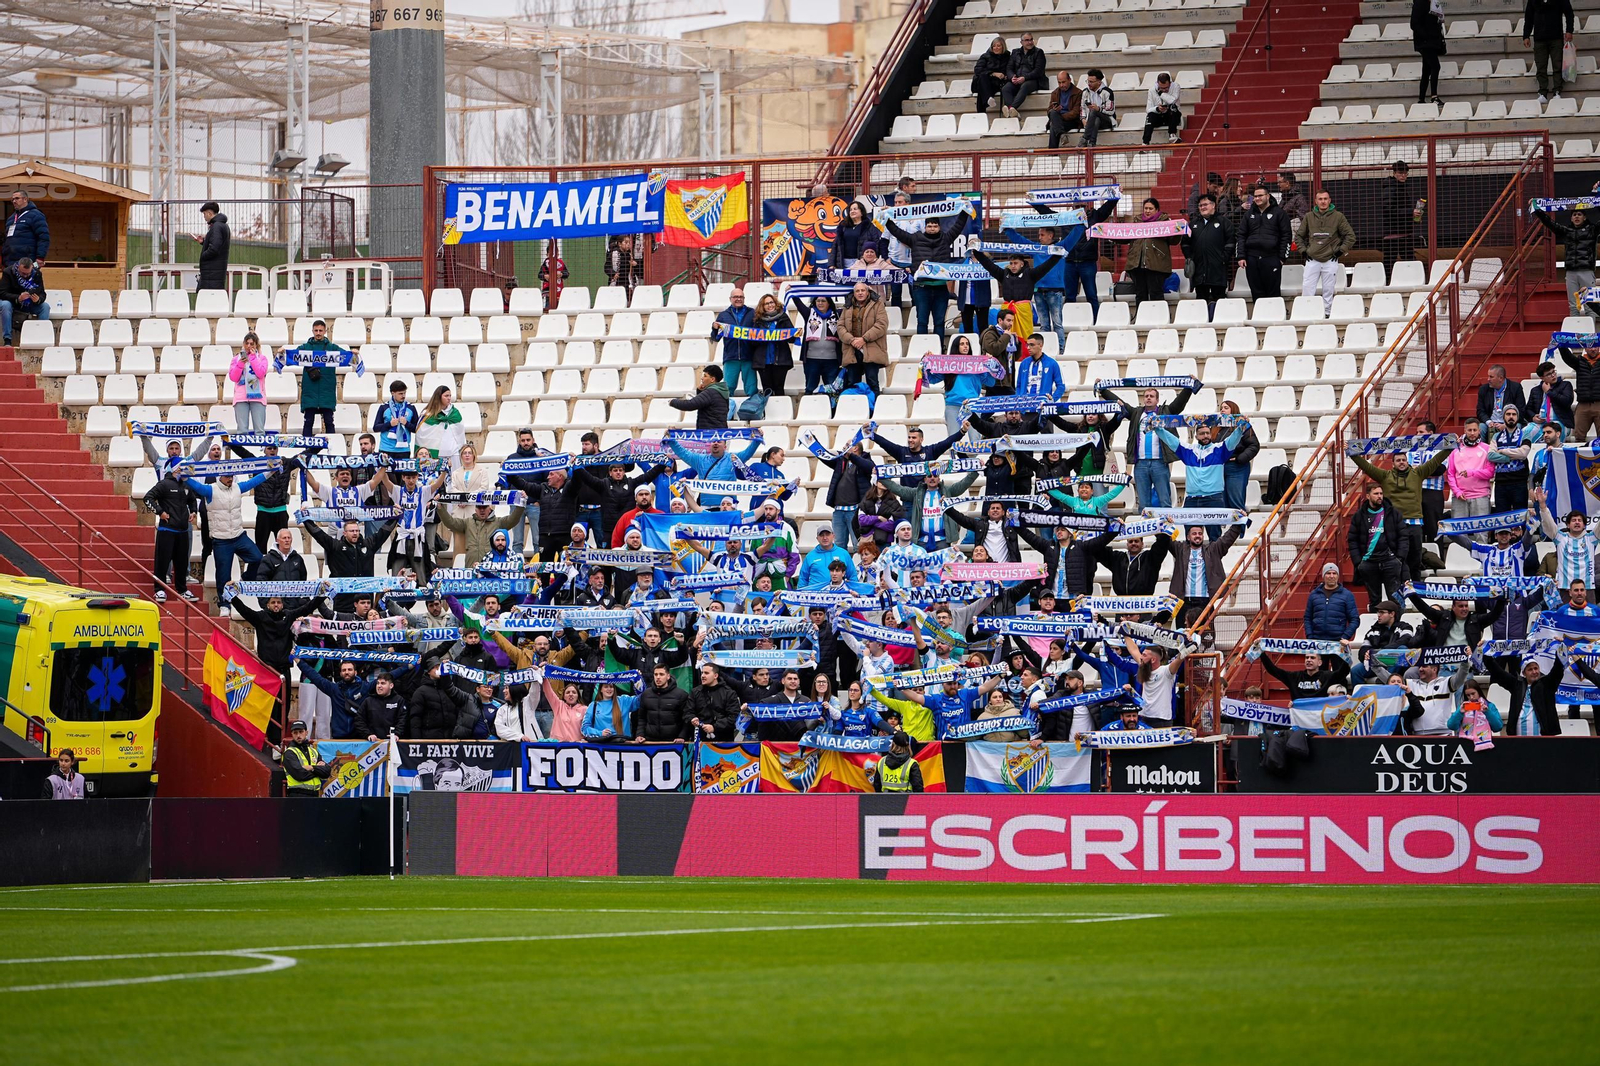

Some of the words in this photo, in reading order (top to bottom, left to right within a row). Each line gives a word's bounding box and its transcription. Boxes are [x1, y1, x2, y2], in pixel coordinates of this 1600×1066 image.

[394, 8, 420, 21] 667
[1036, 192, 1080, 200] MALAGA
[456, 182, 659, 232] BENAMIEL
[911, 202, 955, 216] HICIMOS!
[1106, 226, 1171, 237] MALAGUISTA
[765, 237, 787, 262] MALAGA
[733, 326, 791, 340] BENAMIEL
[1135, 377, 1194, 387] SUPERPANTERA
[164, 424, 205, 434] HERRERO
[229, 434, 275, 444] FONDO
[296, 437, 324, 446] SUR
[675, 431, 744, 441] MALAGA
[505, 462, 532, 470] PORQUE
[542, 458, 566, 467] QUIERO
[877, 464, 925, 477] FONDO
[952, 460, 982, 469] SUR
[692, 480, 759, 492] INVENCIBLES
[1025, 515, 1059, 526] SOMOS
[1061, 515, 1107, 527] GRANDES
[1451, 517, 1500, 531] MALAGA
[698, 525, 762, 537] MALAGA
[1120, 522, 1157, 536] NCIBLES
[588, 553, 651, 563] INVENCIBLES
[891, 551, 943, 569] MALAGA
[435, 569, 472, 580] ONDO
[683, 572, 740, 584] MALAGA
[957, 569, 1032, 579] MALAGUISTA
[440, 581, 510, 593] MALAKAS
[515, 581, 531, 592] 01
[1426, 584, 1477, 594] MALAGA
[911, 586, 971, 601] MALAGA
[1093, 600, 1156, 609] INVENCIBLES
[73, 625, 144, 637] AMBULANCIA
[1013, 623, 1042, 631] PORQUE
[1044, 624, 1053, 632] TE
[356, 631, 403, 643] FONDO
[424, 628, 454, 640] SUR
[1425, 647, 1461, 656] MALAGA
[725, 659, 788, 667] BLANQUIAZULES
[1424, 657, 1433, 665] LA
[443, 662, 484, 683] FONDO
[503, 670, 533, 685] SUR
[1045, 687, 1123, 710] MALAGA
[750, 704, 822, 719] MALAGA
[957, 719, 1002, 733] QUEREMOS
[1100, 734, 1171, 745] INVENCIBLES
[85, 747, 101, 755] 686
[409, 745, 423, 757] EL
[426, 745, 459, 757] FARY
[462, 745, 494, 758] VIVE
[1370, 744, 1473, 769] AQUA
[323, 763, 365, 798] MALAGA
[365, 747, 386, 765] C.F.
[527, 747, 682, 790] FONDO
[1012, 758, 1034, 775] MALAGA
[1125, 765, 1201, 786] Mahou
[1375, 772, 1468, 793] DEUS
[864, 800, 1544, 874] ESCRÍBENOS
